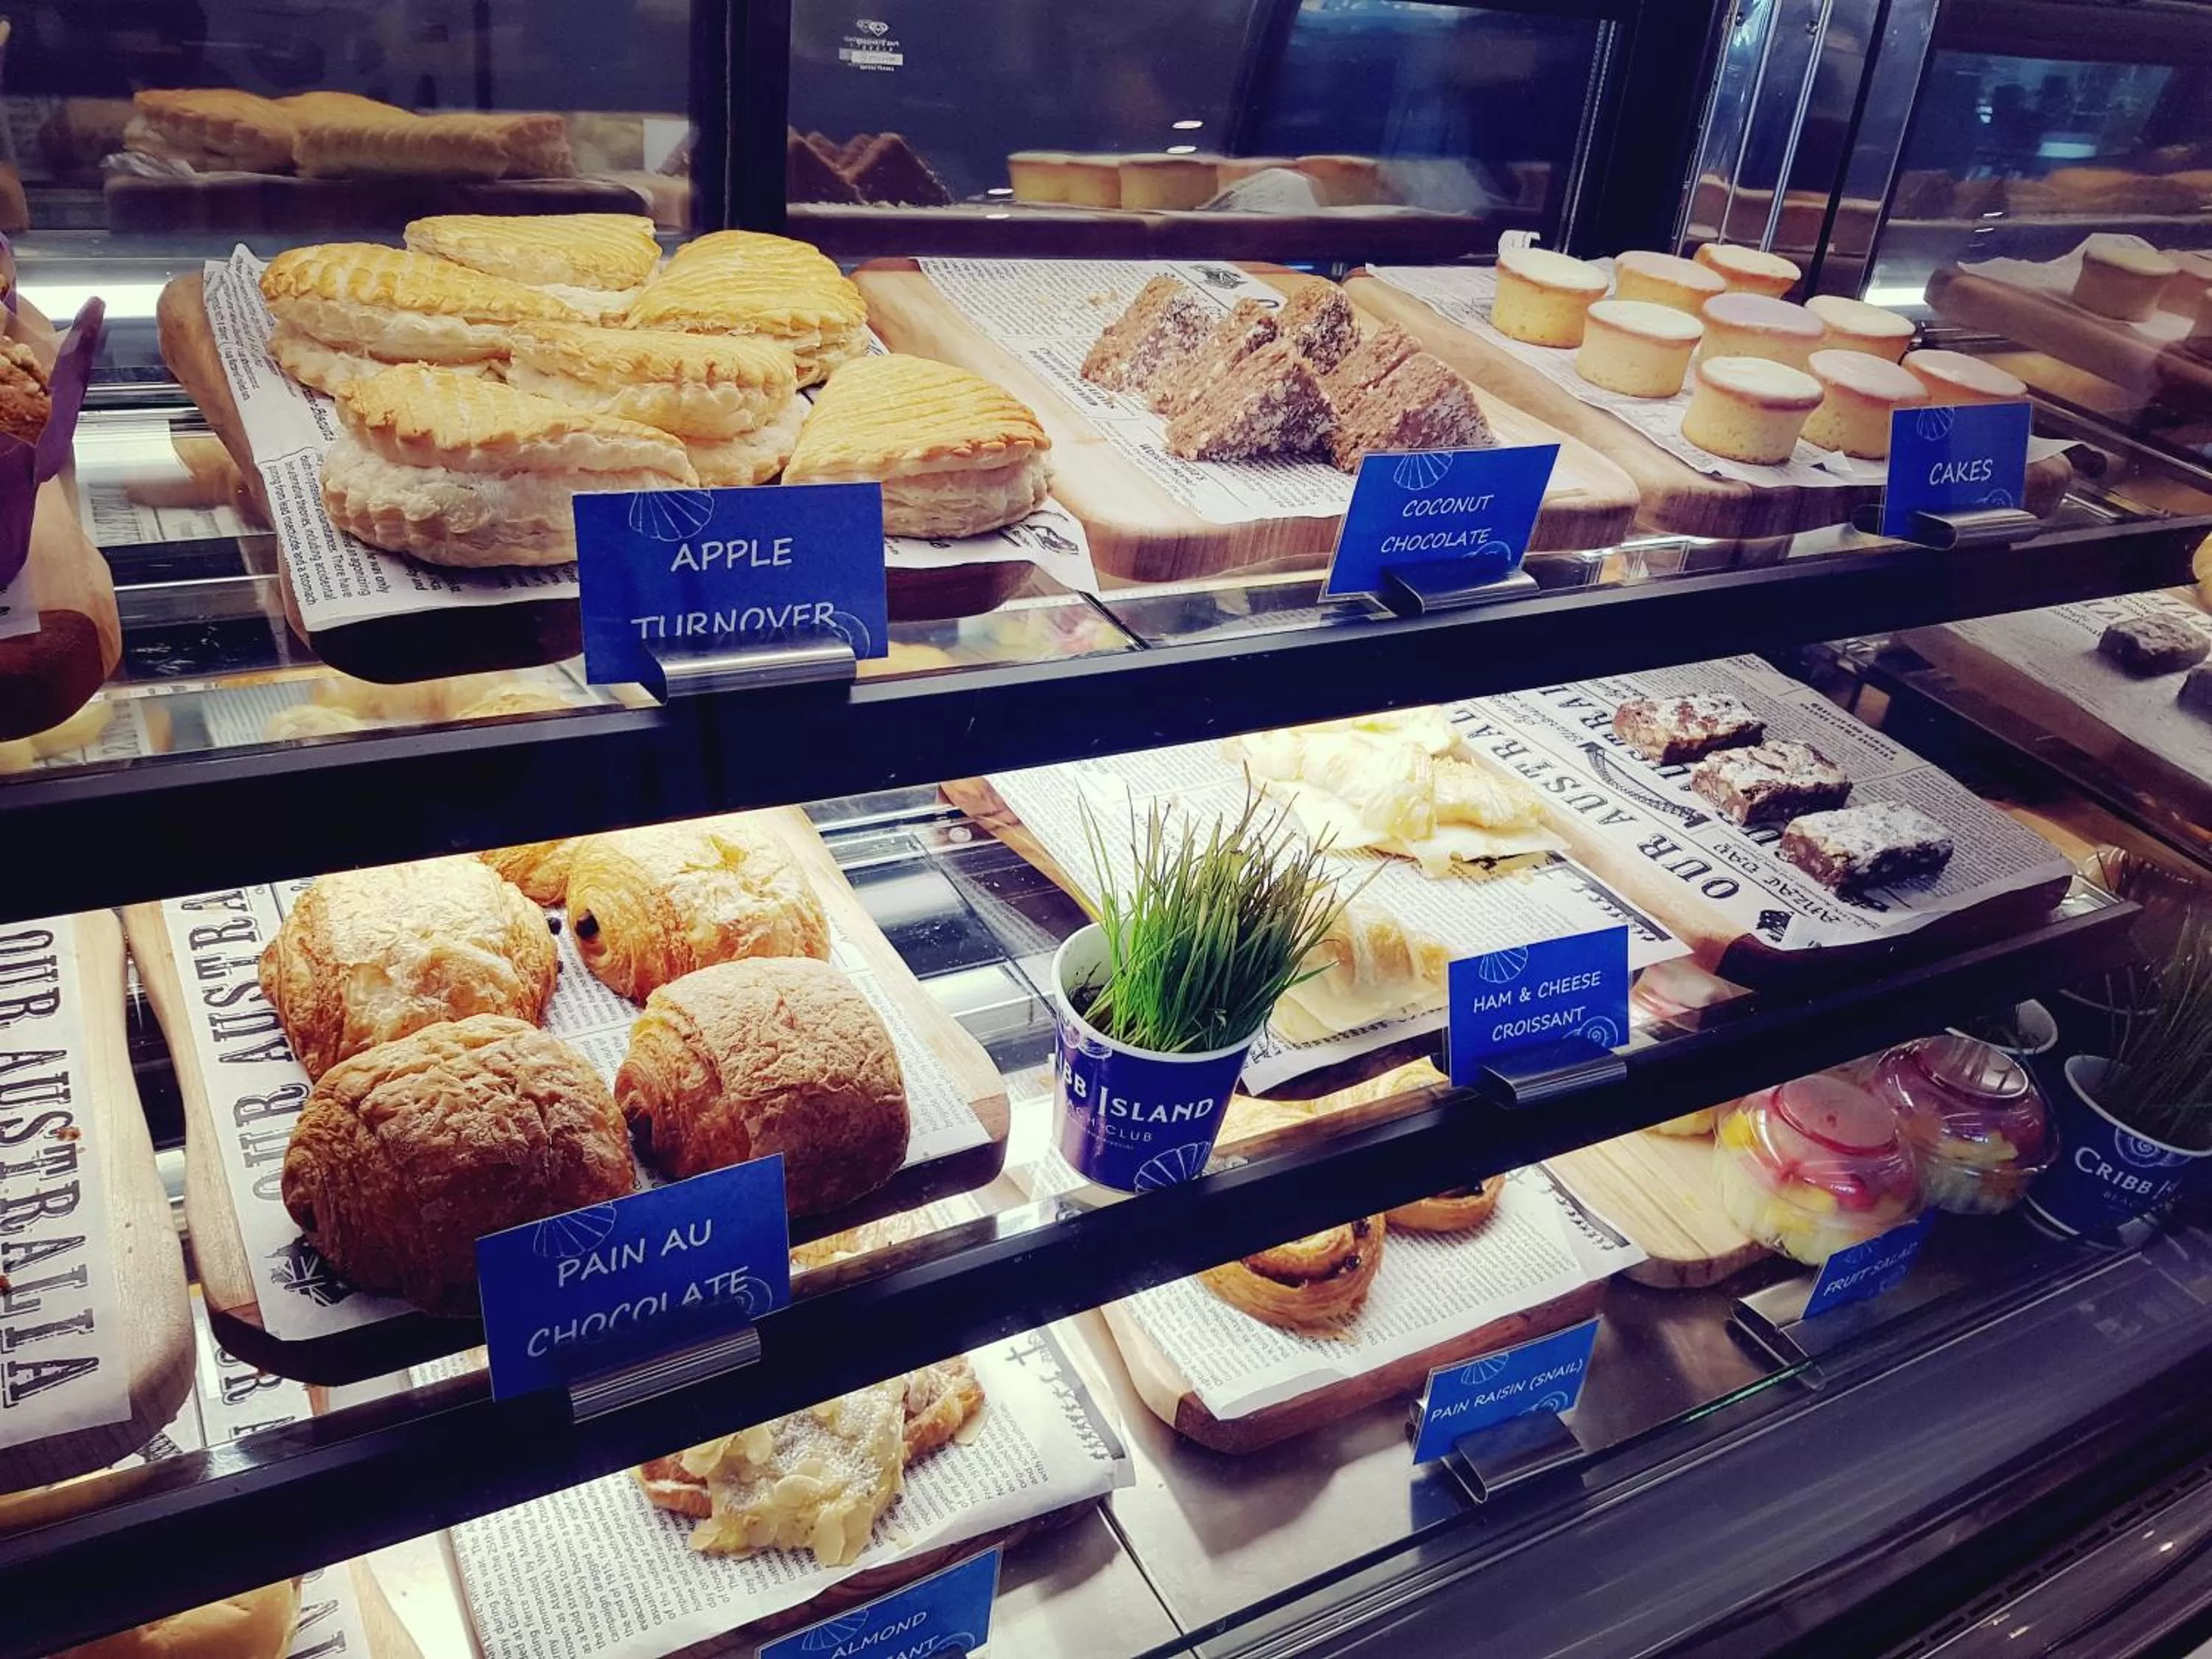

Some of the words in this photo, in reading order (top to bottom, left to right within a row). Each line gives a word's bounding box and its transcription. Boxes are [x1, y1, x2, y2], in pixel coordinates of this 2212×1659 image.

[1929, 459, 1993, 486] CAKES
[1402, 495, 1495, 517] COCONUT
[1381, 527, 1492, 553] CHOCOLATE
[301, 527, 323, 562] including
[313, 560, 336, 601] accidental
[330, 554, 347, 577] There
[669, 536, 793, 574] APPLE
[298, 571, 318, 605] stomach
[338, 577, 355, 599] have
[372, 574, 391, 595] only
[1450, 708, 1639, 827] AUSTRAL
[1636, 832, 1740, 900] OUR
[0, 930, 61, 1031] OUR
[1472, 990, 1512, 1015] HAM
[1518, 987, 1531, 1003] &
[1537, 970, 1601, 999] CHEESE
[1492, 1006, 1586, 1042] CROISSANT
[1098, 1085, 1214, 1123] ISLAND
[1105, 1124, 1153, 1143] CLUB
[2074, 1147, 2154, 1194] CRIBB
[0, 1047, 100, 1408] AUSTRALIA
[557, 1237, 646, 1289] PAIN
[660, 1218, 712, 1258] AU
[1430, 1399, 1472, 1423] PAIN
[1474, 1380, 1526, 1407] RAISIN
[1528, 1358, 1584, 1391] (SNAIL)
[524, 1518, 539, 1538] had
[624, 1512, 646, 1547] Gallipoli
[638, 1511, 653, 1528] and
[495, 1525, 510, 1549] from
[509, 1518, 530, 1558] Mustafa
[542, 1524, 555, 1540] the
[578, 1537, 589, 1550] on
[468, 1536, 481, 1555] The
[530, 1539, 548, 1566] What
[548, 1541, 564, 1569] knock
[562, 1538, 582, 1575] became
[594, 1543, 608, 1559] the
[607, 1539, 622, 1559] both
[639, 1547, 650, 1558] at
[490, 1554, 502, 1572] the
[521, 1559, 535, 1573] by
[581, 1551, 606, 1593] dragged
[614, 1559, 631, 1583] after
[631, 1563, 646, 1580] and
[644, 1557, 664, 1588] landing
[670, 1553, 684, 1568] the
[496, 1572, 507, 1587] on
[506, 1551, 525, 1597] resistance
[557, 1569, 568, 1582] to
[678, 1569, 692, 1587] and
[698, 1578, 709, 1590] on
[481, 1579, 495, 1598] the
[560, 1582, 577, 1610] strike
[574, 1574, 595, 1610] quickly
[609, 1587, 621, 1599] of
[657, 1590, 671, 1607] the
[719, 1591, 731, 1604] of
[498, 1587, 519, 1630] Gallipoli
[518, 1599, 535, 1628] fierce
[527, 1576, 554, 1635] commanded
[613, 1600, 628, 1619] end
[622, 1582, 649, 1632] evacuated
[637, 1581, 663, 1627] casualties
[664, 1608, 677, 1621] of
[487, 1599, 507, 1635] during
[555, 1612, 566, 1624] as
[568, 1610, 585, 1635] bold
[587, 1610, 599, 1630] war
[596, 1594, 622, 1642] campaign
[620, 1619, 635, 1637] the
[511, 1629, 522, 1642] at
[593, 1630, 606, 1649] the
[831, 1610, 928, 1659] ALMOND
[581, 1643, 592, 1655] as
